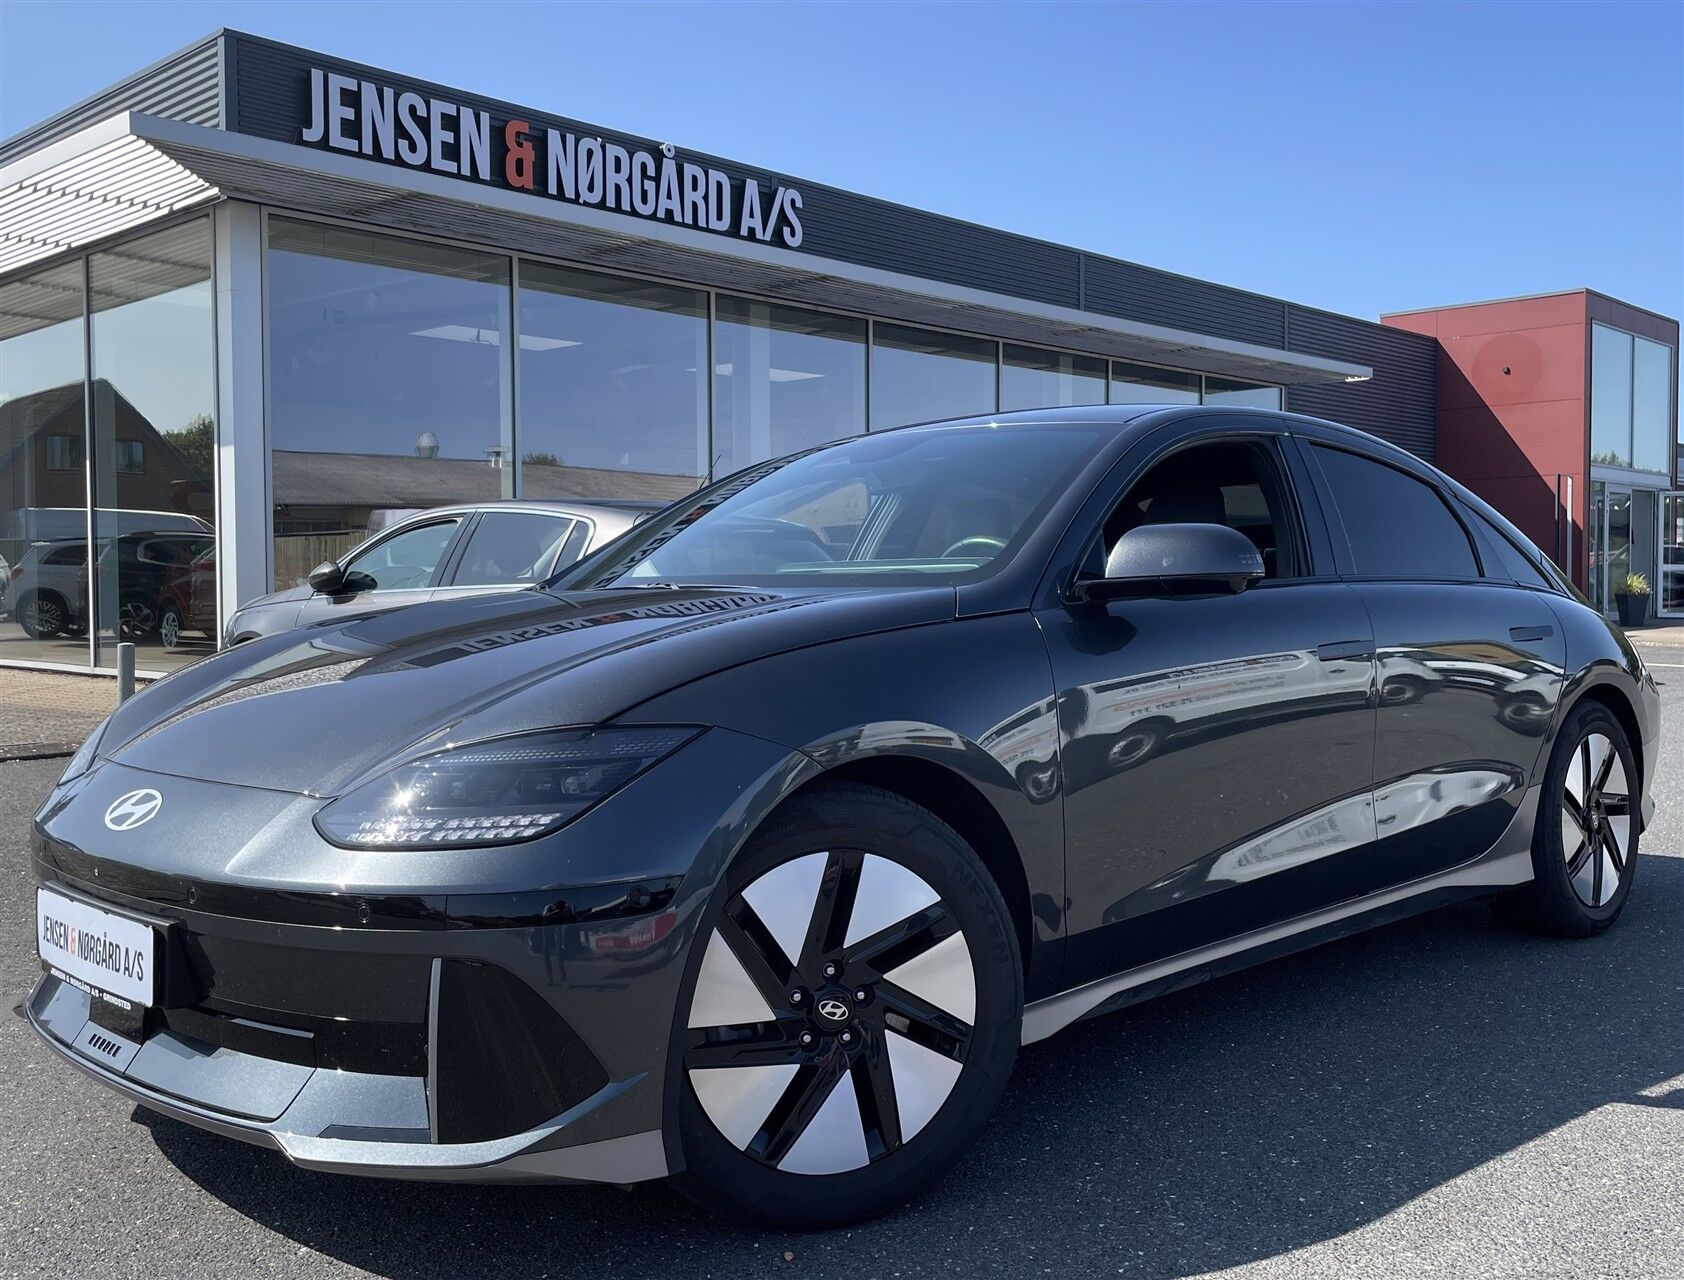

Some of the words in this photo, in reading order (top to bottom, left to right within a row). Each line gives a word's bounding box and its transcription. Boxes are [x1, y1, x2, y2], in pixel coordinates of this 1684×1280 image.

[302, 68, 491, 181] JENSEN
[505, 120, 535, 190] &
[547, 142, 731, 232] NØRGÅRD
[740, 178, 804, 248] A/S
[43, 914, 70, 952] JENSEN
[69, 927, 77, 957] &
[77, 931, 121, 973] NØRGÅRD
[123, 947, 144, 982] A/S
